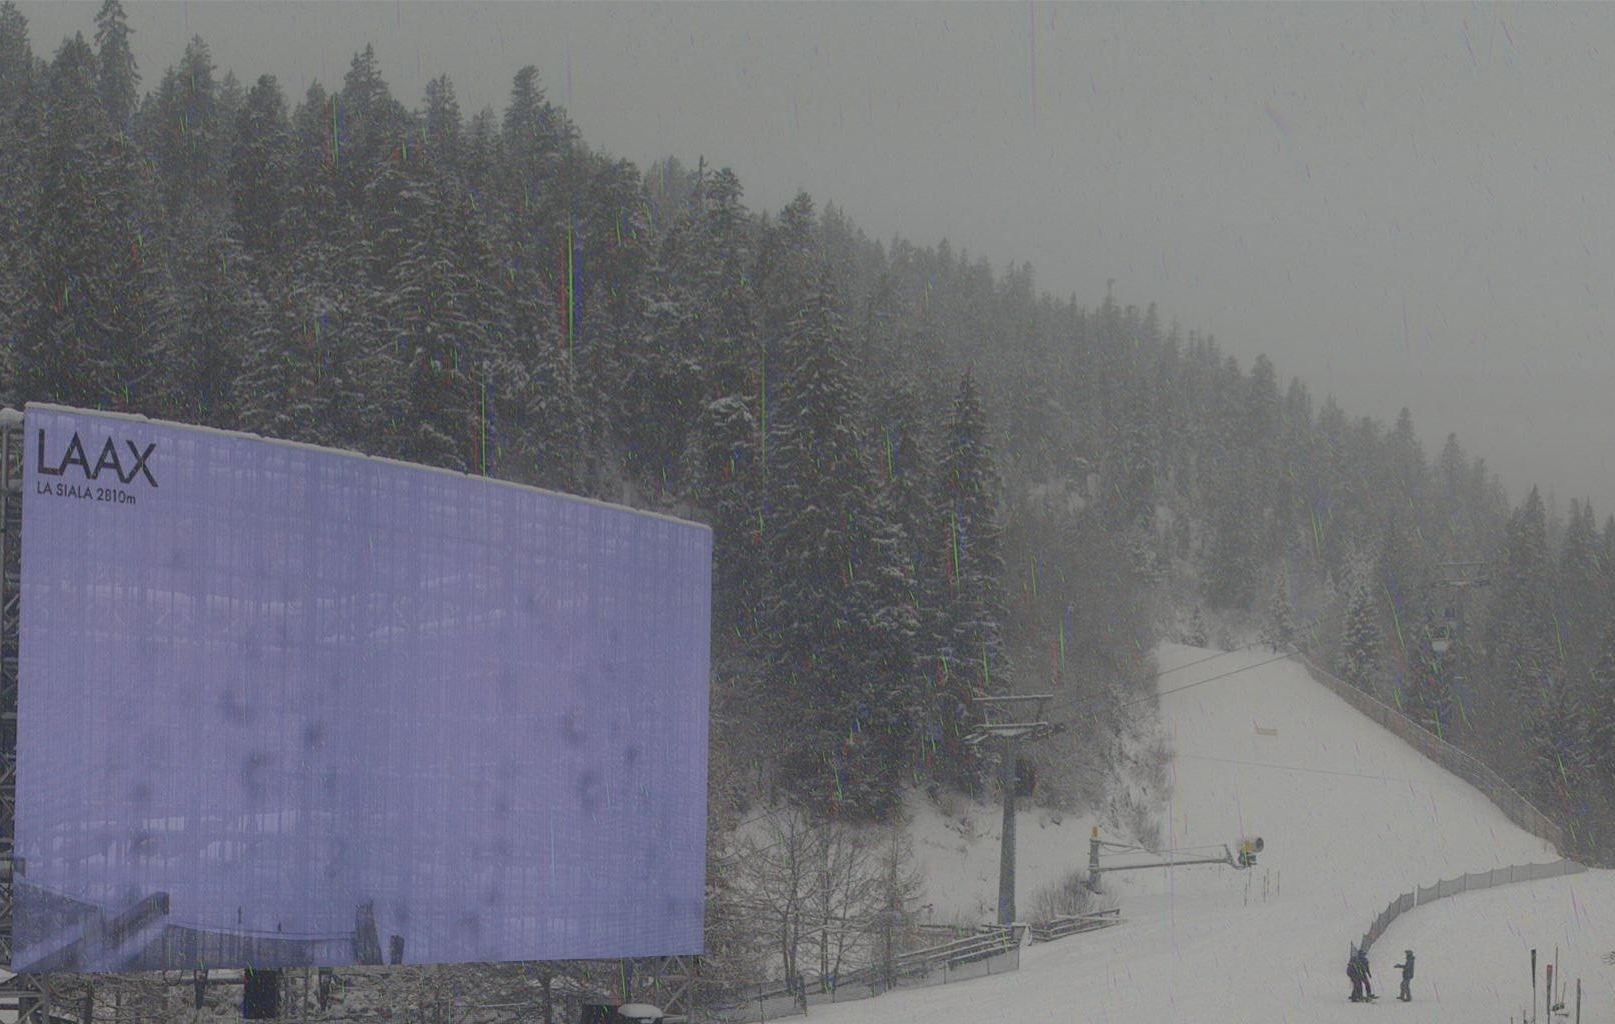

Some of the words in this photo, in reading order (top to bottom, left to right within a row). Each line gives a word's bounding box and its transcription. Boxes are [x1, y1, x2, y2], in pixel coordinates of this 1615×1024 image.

[38, 428, 159, 488] LAAX
[37, 481, 53, 496] LA
[56, 483, 93, 500] SIALA
[96, 488, 136, 505] 2810m
